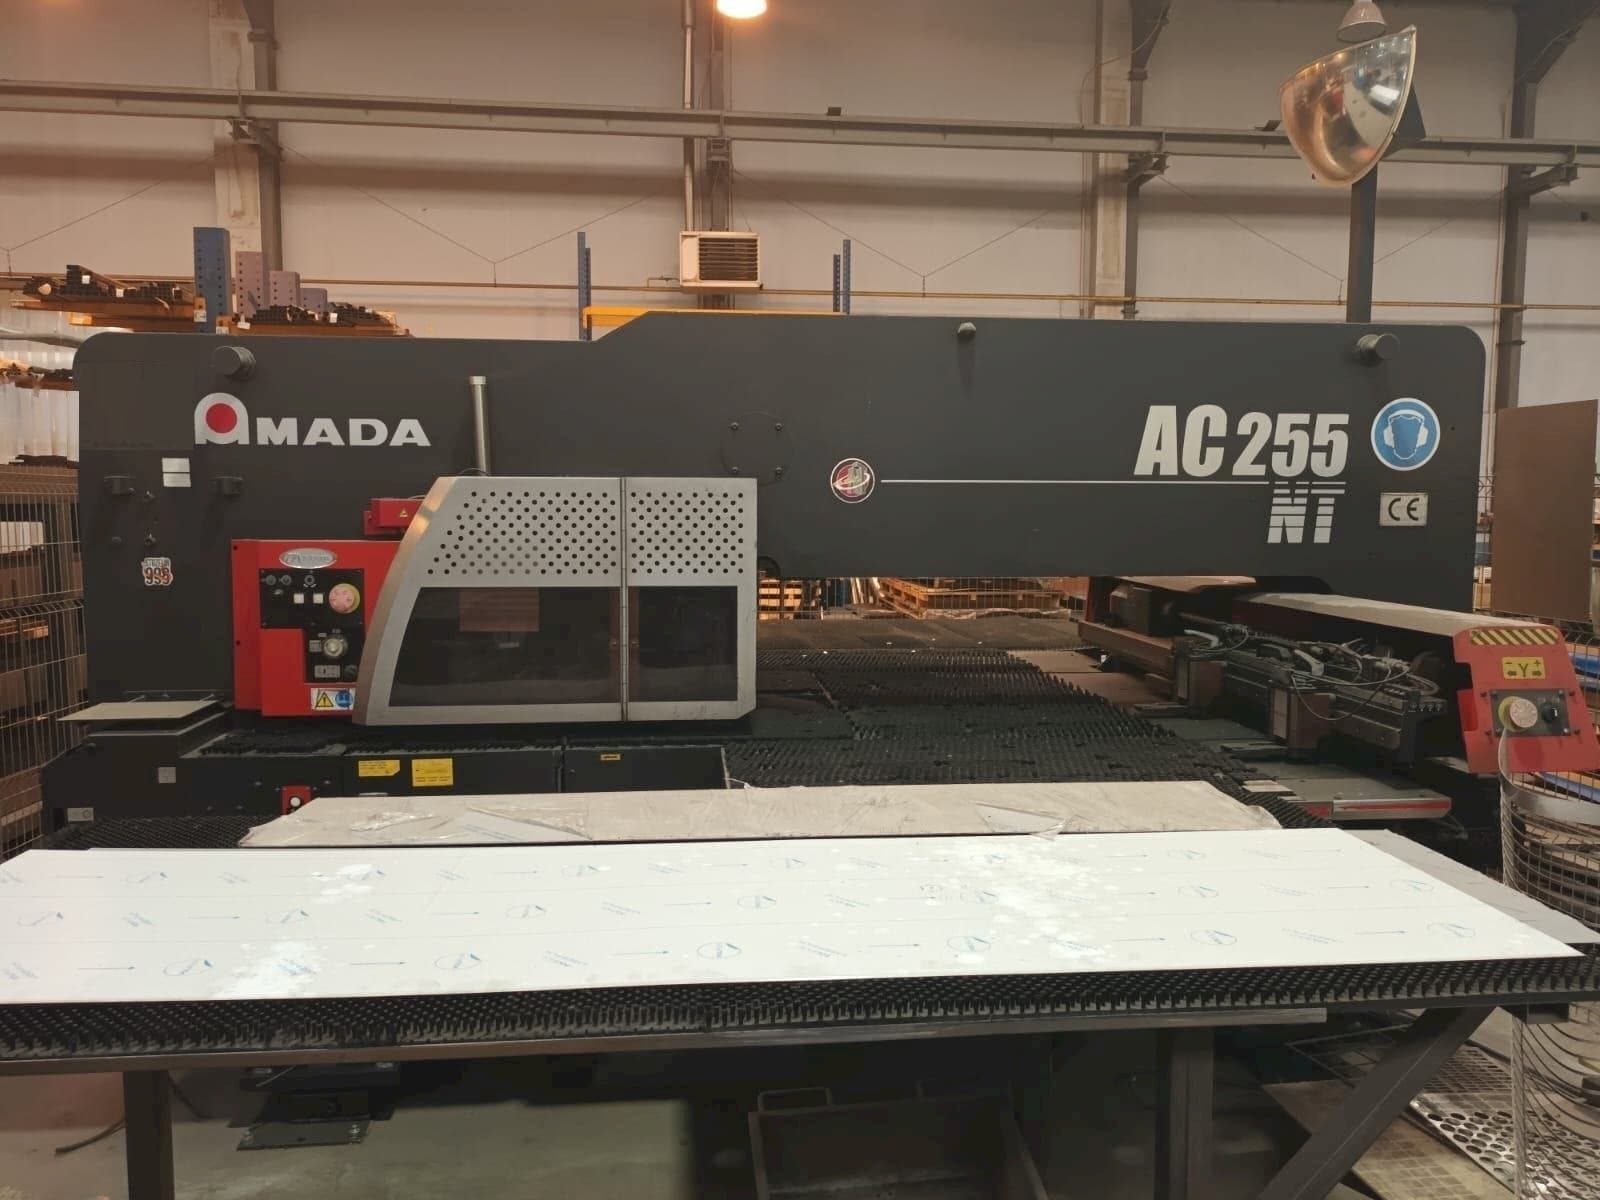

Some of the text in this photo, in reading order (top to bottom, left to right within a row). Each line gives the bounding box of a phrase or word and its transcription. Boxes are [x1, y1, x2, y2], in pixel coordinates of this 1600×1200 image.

[194, 392, 431, 447] AMADA
[1267, 481, 1346, 543] NT
[1387, 497, 1421, 522] CE
[1518, 663, 1529, 678] Y
